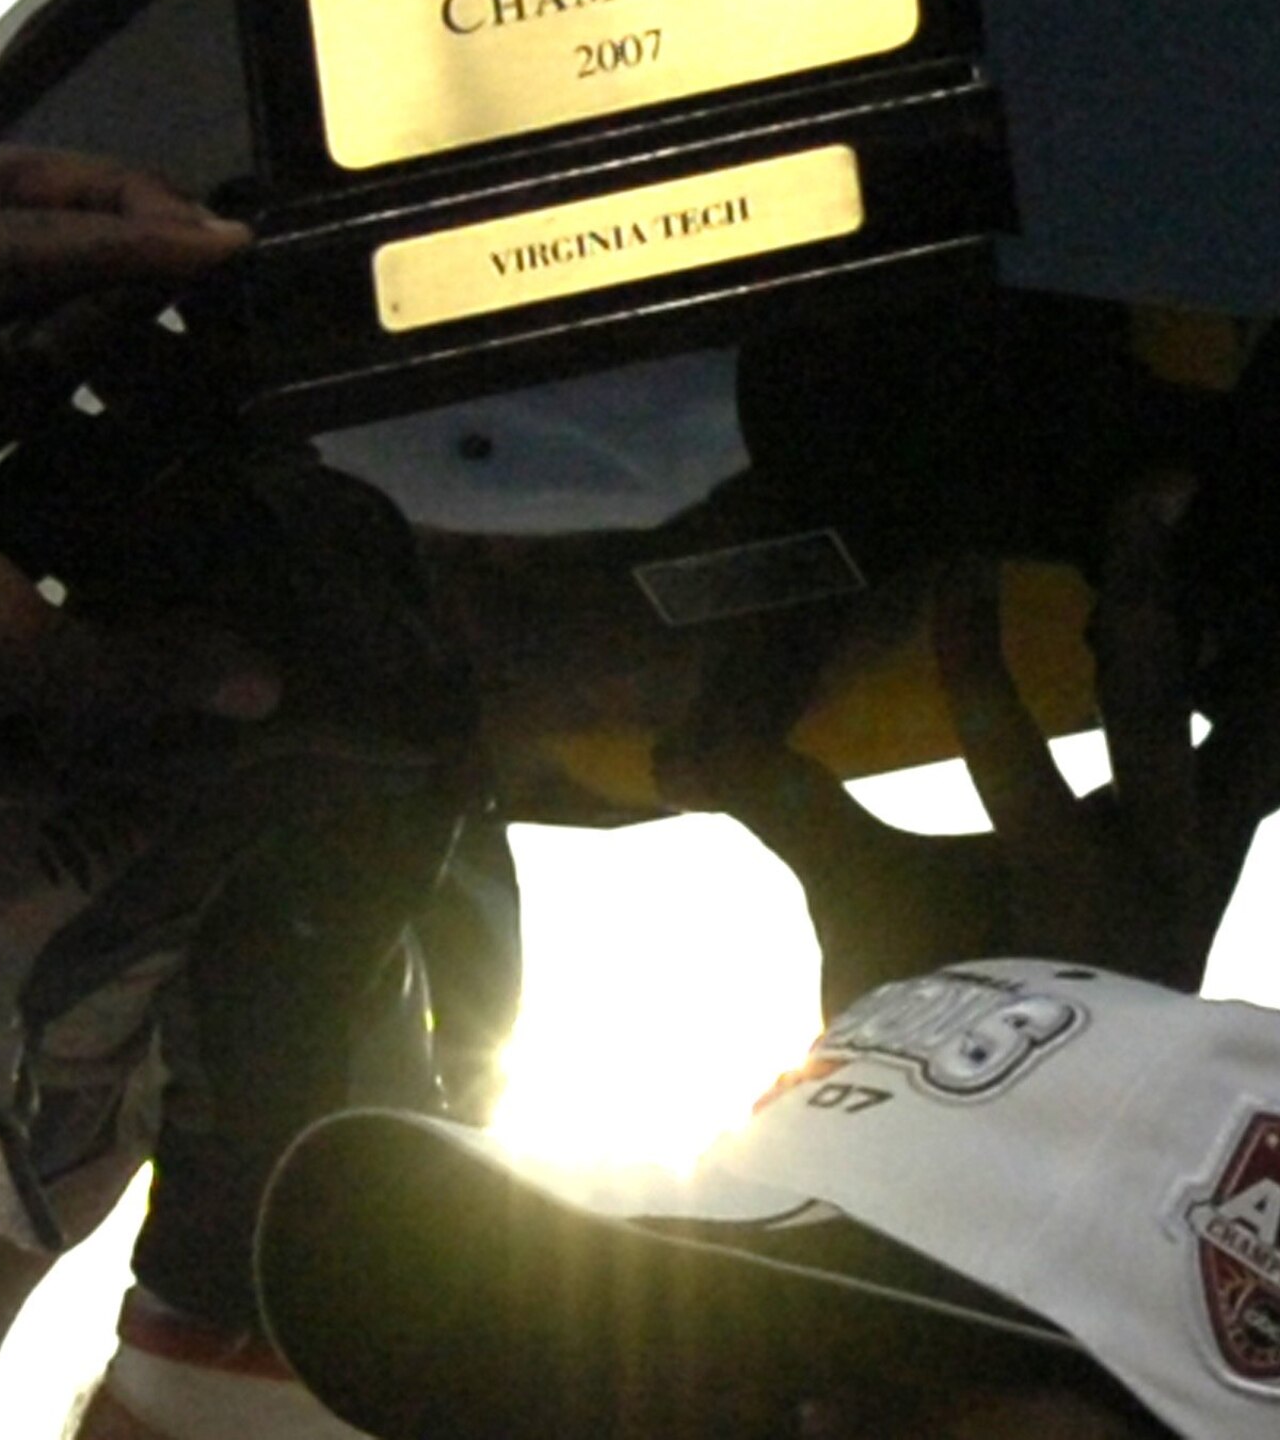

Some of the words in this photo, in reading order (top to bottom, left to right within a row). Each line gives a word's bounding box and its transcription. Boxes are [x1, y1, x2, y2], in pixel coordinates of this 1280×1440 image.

[575, 29, 664, 79] 2007
[489, 222, 648, 278] VIRGINIA
[653, 196, 751, 241] TECH
